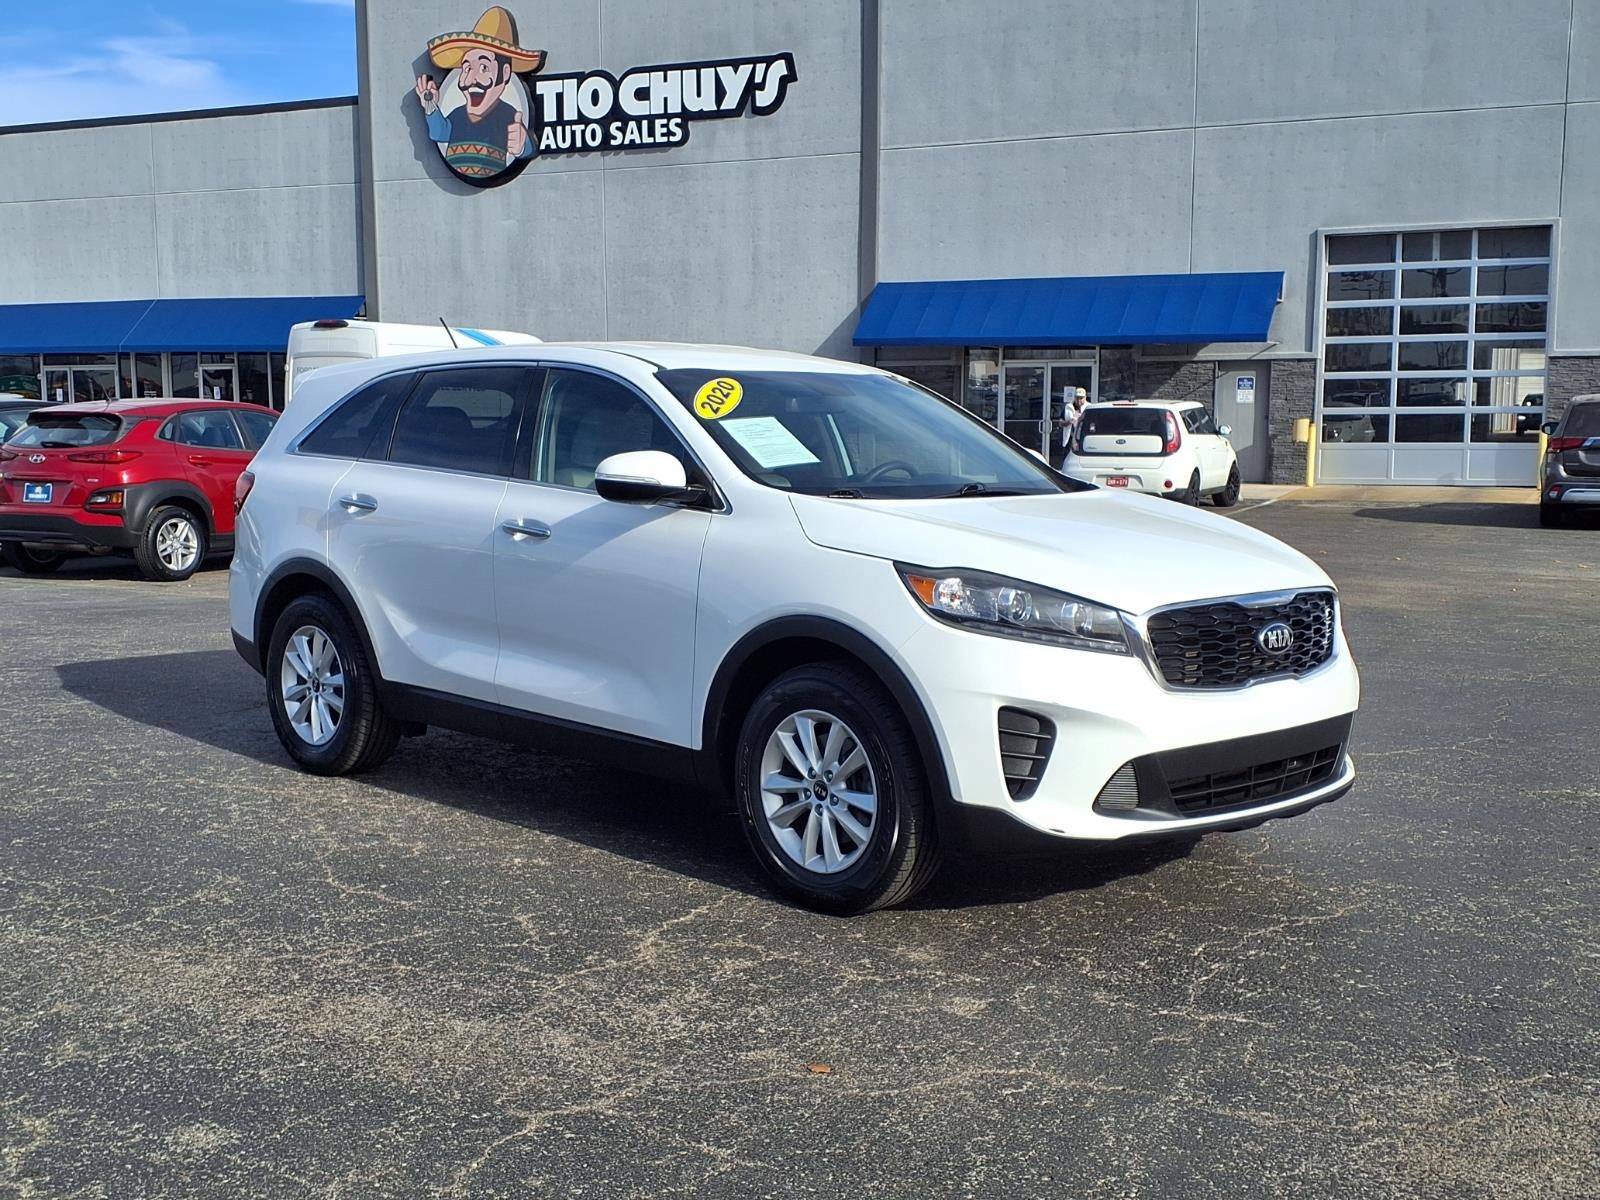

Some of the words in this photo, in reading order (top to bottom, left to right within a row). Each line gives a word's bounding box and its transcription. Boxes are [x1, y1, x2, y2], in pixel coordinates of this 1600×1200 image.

[536, 77, 613, 122] TIO
[618, 59, 788, 116] CHUY'S
[539, 124, 603, 150] AUTO
[609, 118, 683, 146] SALES
[700, 380, 736, 414] 2020
[1267, 629, 1290, 648] KIA
